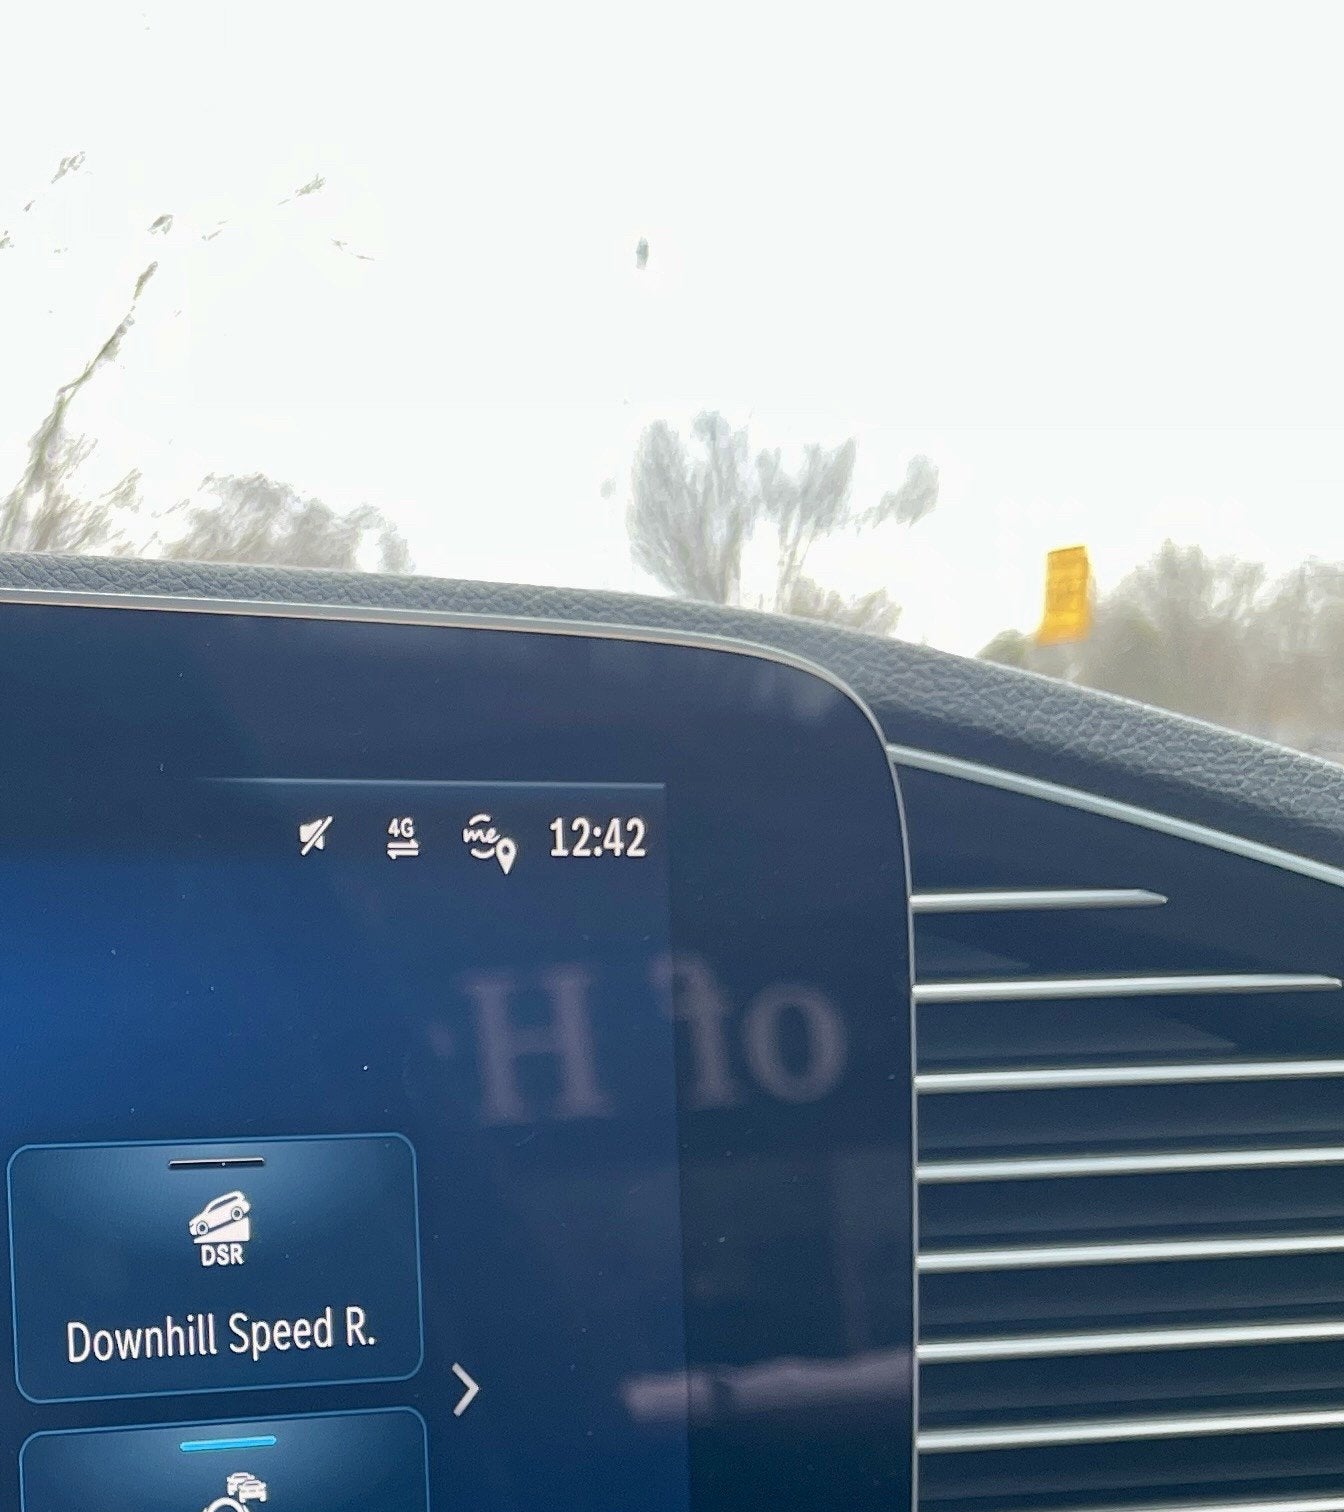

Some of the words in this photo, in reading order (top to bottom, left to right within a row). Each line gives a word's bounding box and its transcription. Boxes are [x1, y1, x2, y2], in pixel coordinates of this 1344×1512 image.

[388, 818, 414, 838] 4G
[549, 816, 646, 857] 12:42
[200, 1243, 245, 1267] DSR
[67, 1312, 218, 1363] Downhill
[228, 1306, 333, 1362] Speed
[345, 1306, 376, 1347] R.
